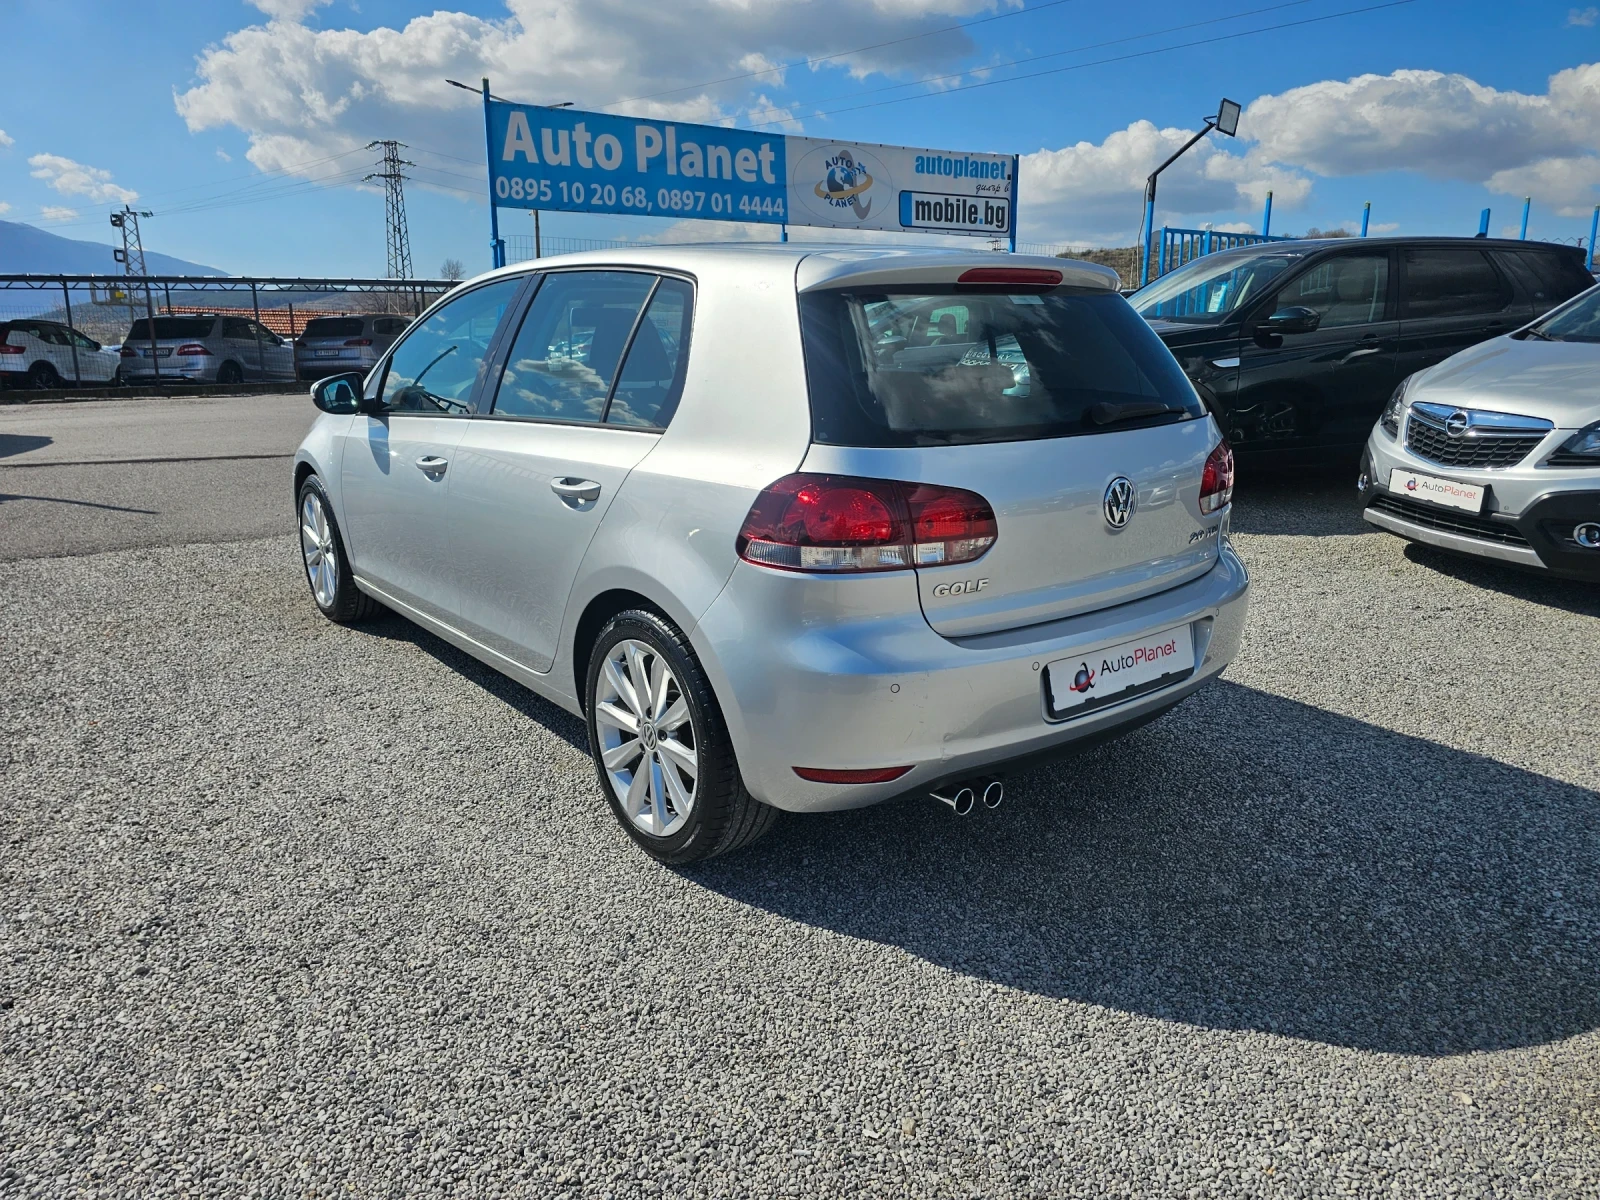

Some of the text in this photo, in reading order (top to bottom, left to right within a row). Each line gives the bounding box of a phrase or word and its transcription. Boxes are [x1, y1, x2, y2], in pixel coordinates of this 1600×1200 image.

[502, 111, 776, 185] Auto Planet
[825, 156, 853, 170] AUTO
[495, 176, 785, 217] 0895 10 20 68, 0897 01 4444
[824, 193, 857, 208] PLANET
[915, 198, 1006, 228] mobile.bg
[1422, 481, 1477, 500] AutoPlanet
[933, 578, 989, 598] GOLF
[1100, 639, 1177, 677] AutoPlanet
